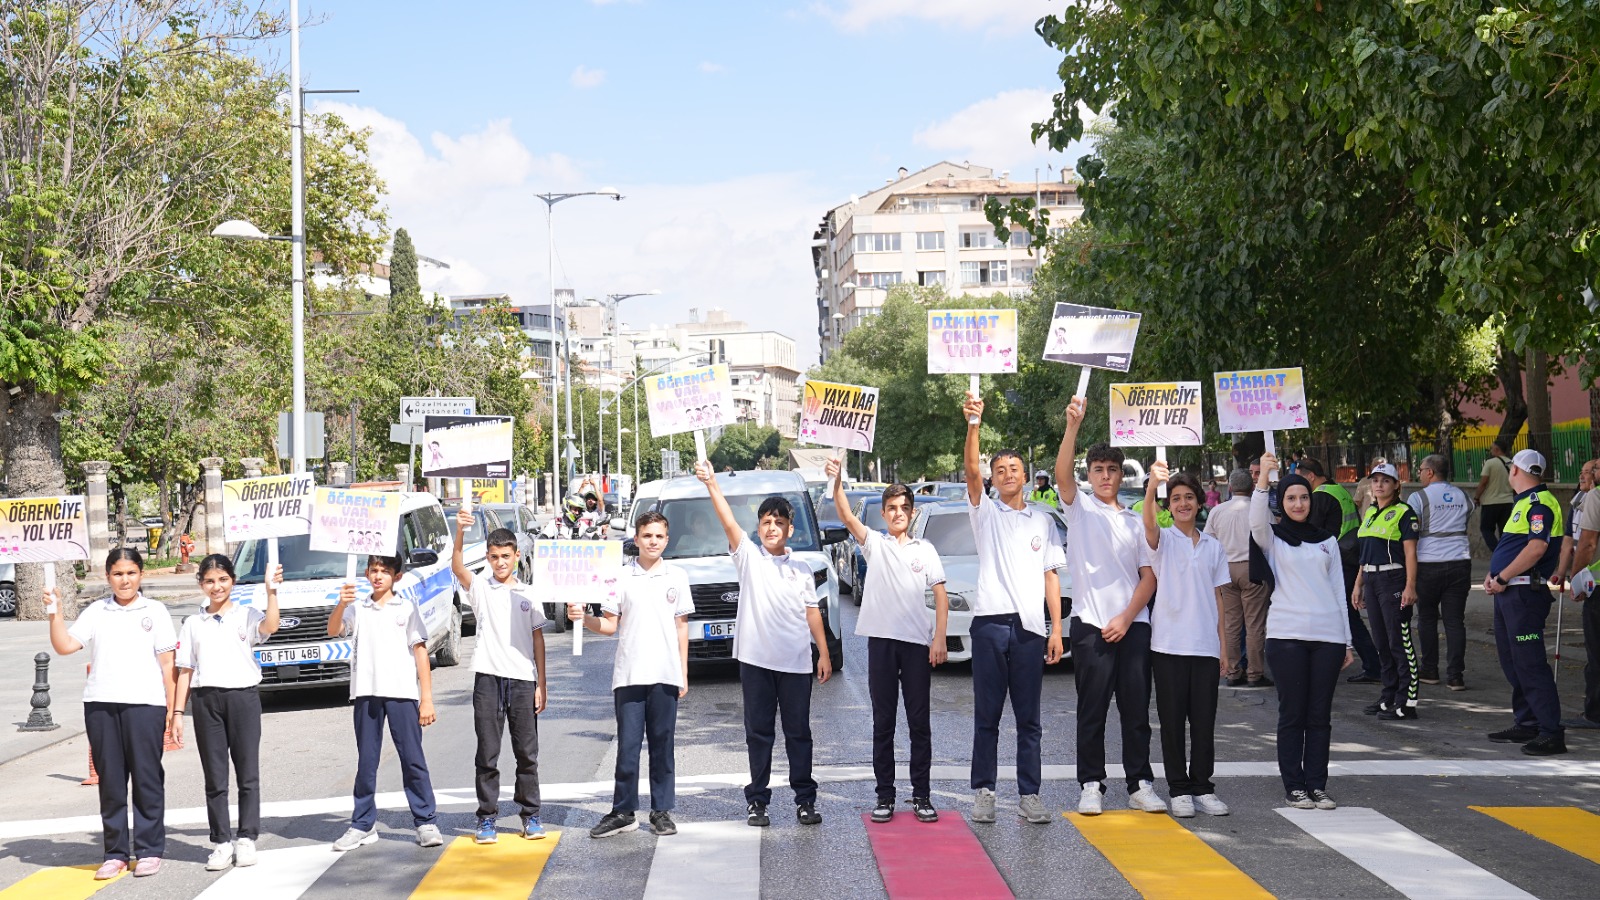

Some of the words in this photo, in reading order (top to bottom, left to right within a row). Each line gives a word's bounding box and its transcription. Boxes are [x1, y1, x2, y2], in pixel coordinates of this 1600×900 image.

[932, 313, 999, 330] DİKKAT
[942, 330, 988, 343] OKUL
[948, 344, 982, 357] VAR
[657, 368, 715, 390] ÖĞRENCİ
[1219, 373, 1286, 390] DİKKAT
[674, 385, 700, 398] VAR
[823, 388, 850, 407] YAYA
[852, 392, 875, 411] VAR
[1128, 386, 1198, 406] ÖĞRENCİYE
[1230, 389, 1277, 403] OKUL
[1139, 409, 1160, 425] YOL
[1164, 408, 1188, 425] VER
[1237, 402, 1272, 416] VAR
[820, 406, 860, 429] DİKKAT
[858, 414, 874, 431] ET
[241, 478, 311, 502] ÖĞRENCİYE
[327, 491, 387, 508] ÖĞRENCİ
[9, 500, 82, 523] ÖĞRENCİYE
[253, 502, 275, 520] YOL
[278, 499, 302, 517] VER
[342, 506, 369, 518] VAR
[321, 515, 388, 530] YAVAŞLA!
[23, 524, 45, 541] YOL
[49, 523, 73, 540] VER
[538, 542, 606, 558] DİKKAT
[547, 559, 594, 572] OKUL
[553, 573, 588, 585] VAR
[711, 625, 722, 635] 06
[261, 652, 272, 662] 06
[278, 650, 296, 661] FTU
[301, 648, 318, 659] 485
